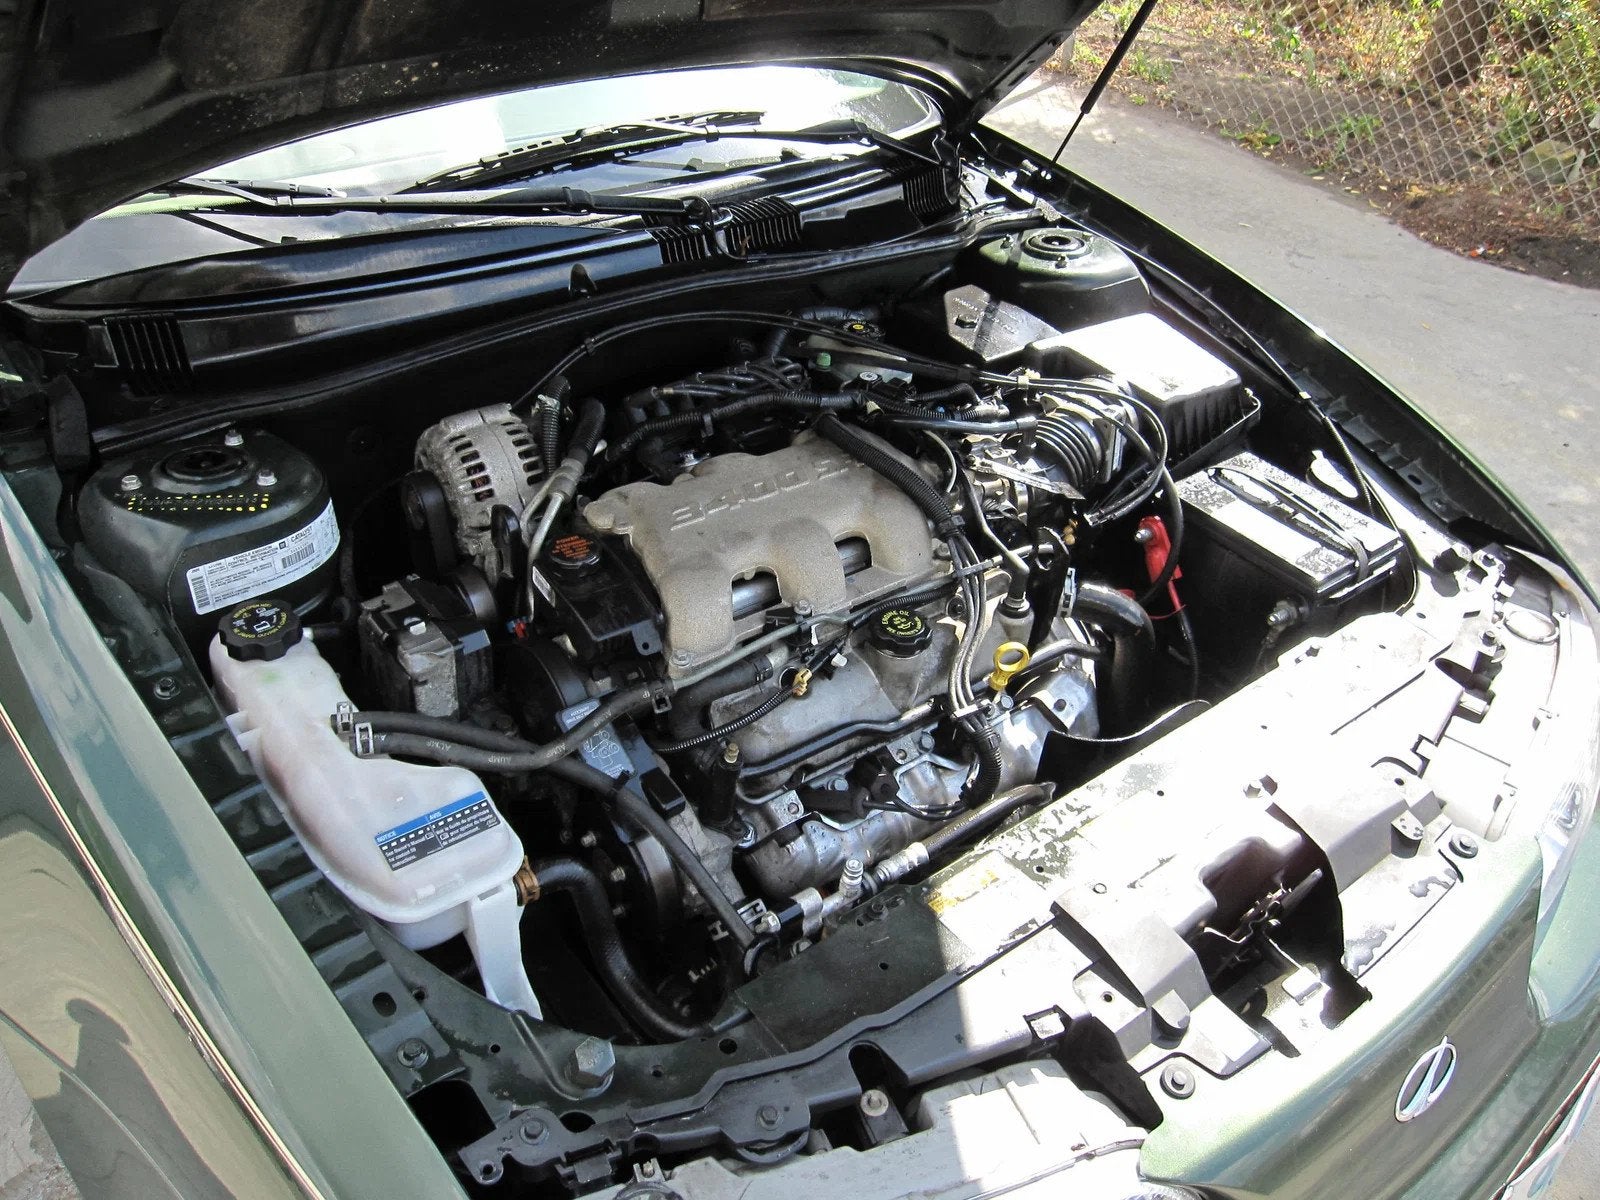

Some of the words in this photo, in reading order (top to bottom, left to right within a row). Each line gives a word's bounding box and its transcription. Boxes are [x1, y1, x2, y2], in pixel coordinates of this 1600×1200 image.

[670, 472, 811, 531] 3400
[290, 526, 313, 542] CATALYST
[881, 610, 898, 625] ENGINE
[429, 812, 442, 821] AVIS
[376, 830, 397, 843] NOTICE
